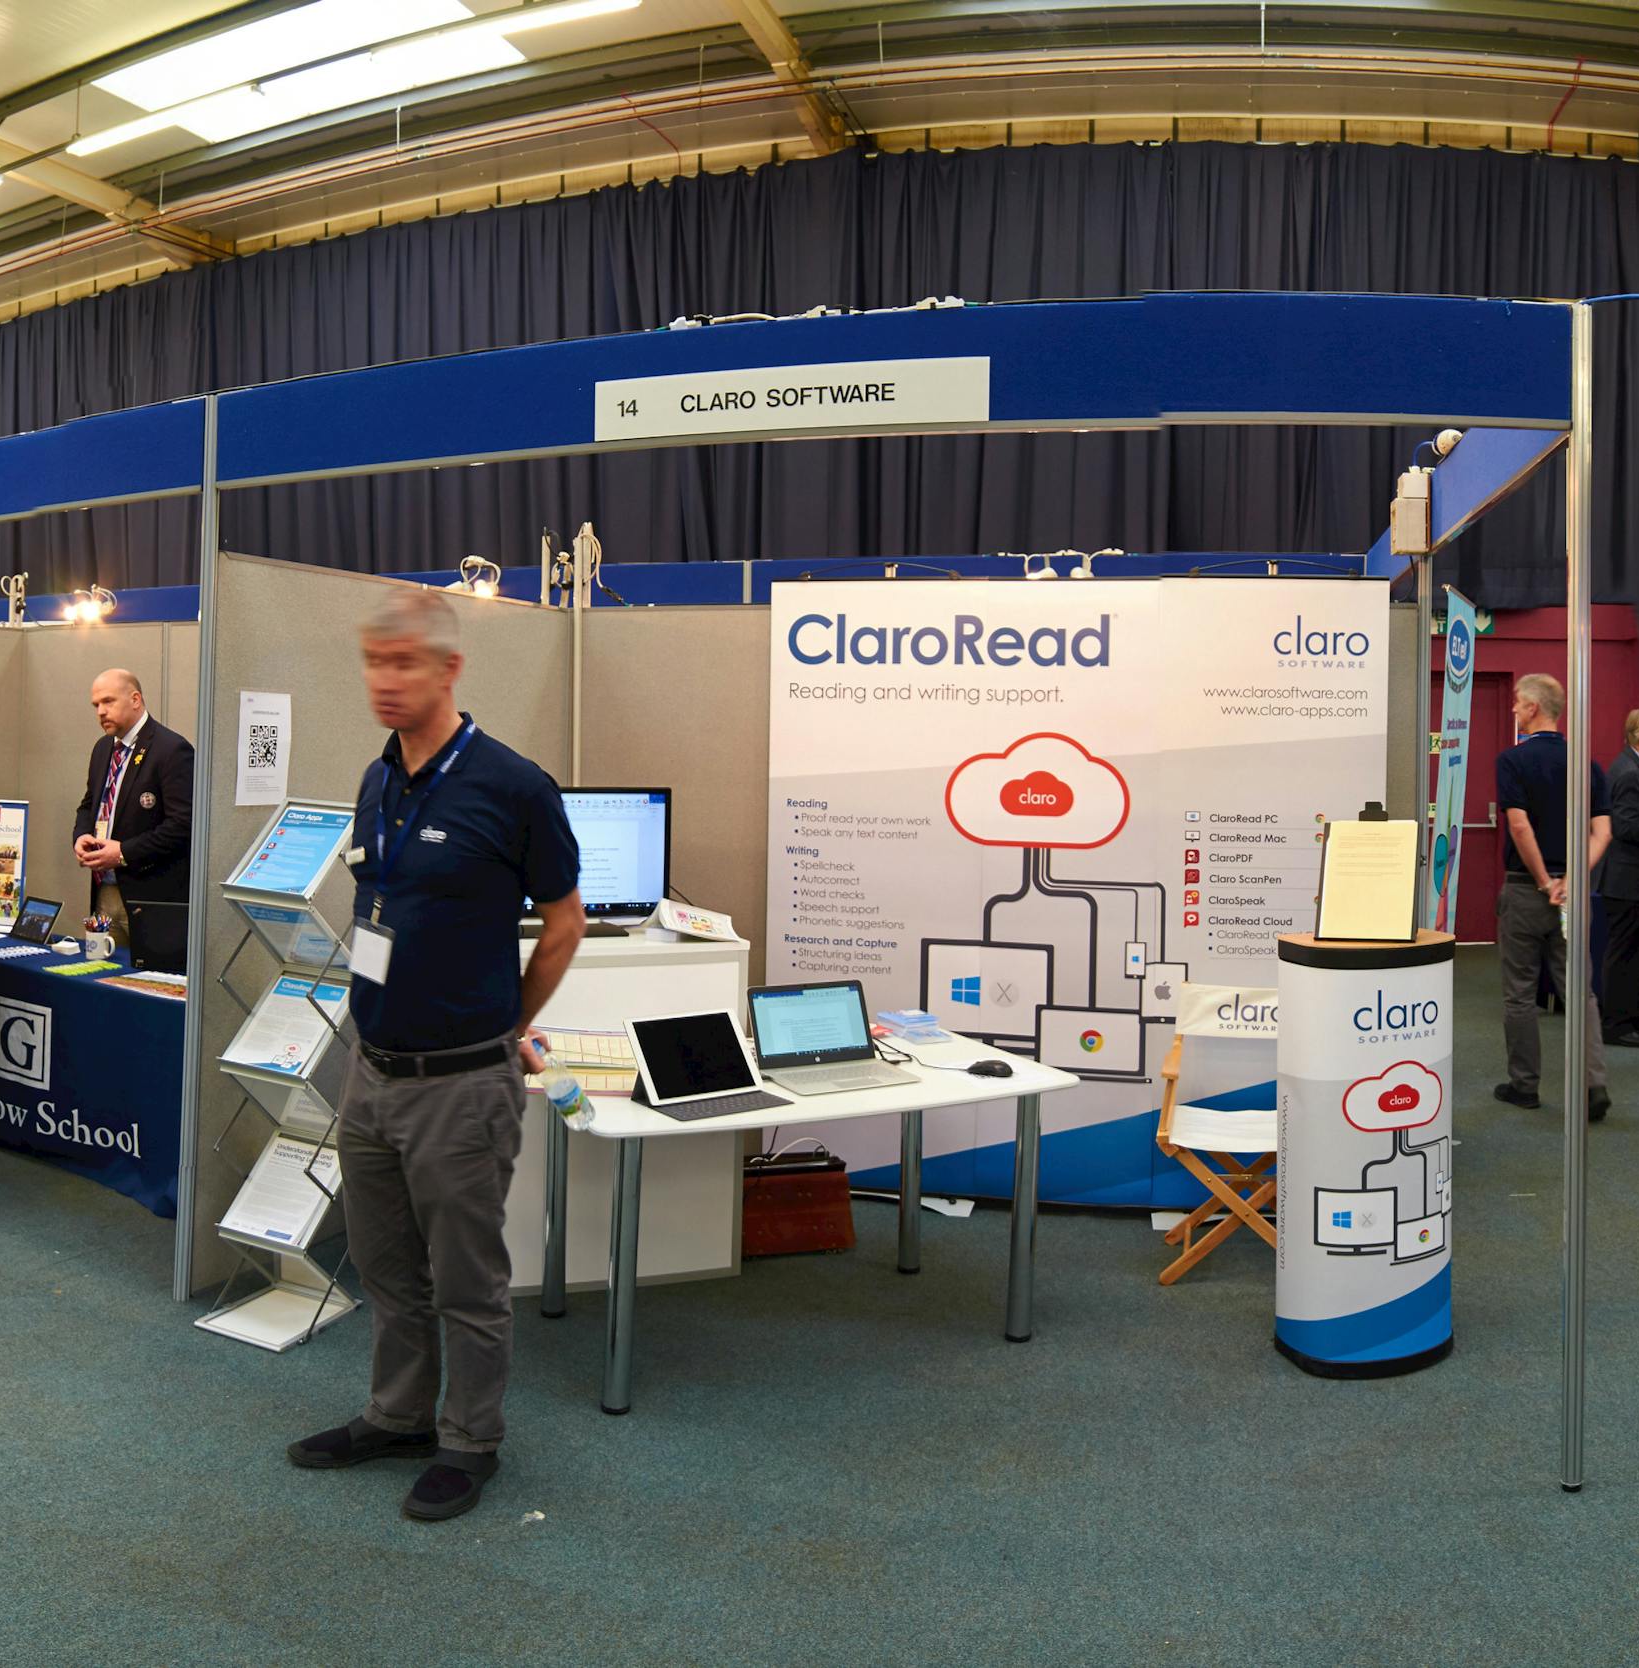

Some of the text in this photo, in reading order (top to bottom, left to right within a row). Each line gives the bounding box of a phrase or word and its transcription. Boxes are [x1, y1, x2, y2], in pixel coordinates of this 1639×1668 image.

[617, 382, 895, 417] 14 CLARO SOFTWARE
[788, 613, 1111, 667] ClaroRead
[789, 683, 1064, 705] Reading and writing support.
[1203, 686, 1368, 700] www.clarosoftware.com
[1220, 704, 1368, 719] www.claro-apps.com
[1209, 896, 1265, 907] ClaroSpeak
[35, 1100, 142, 1159] School
